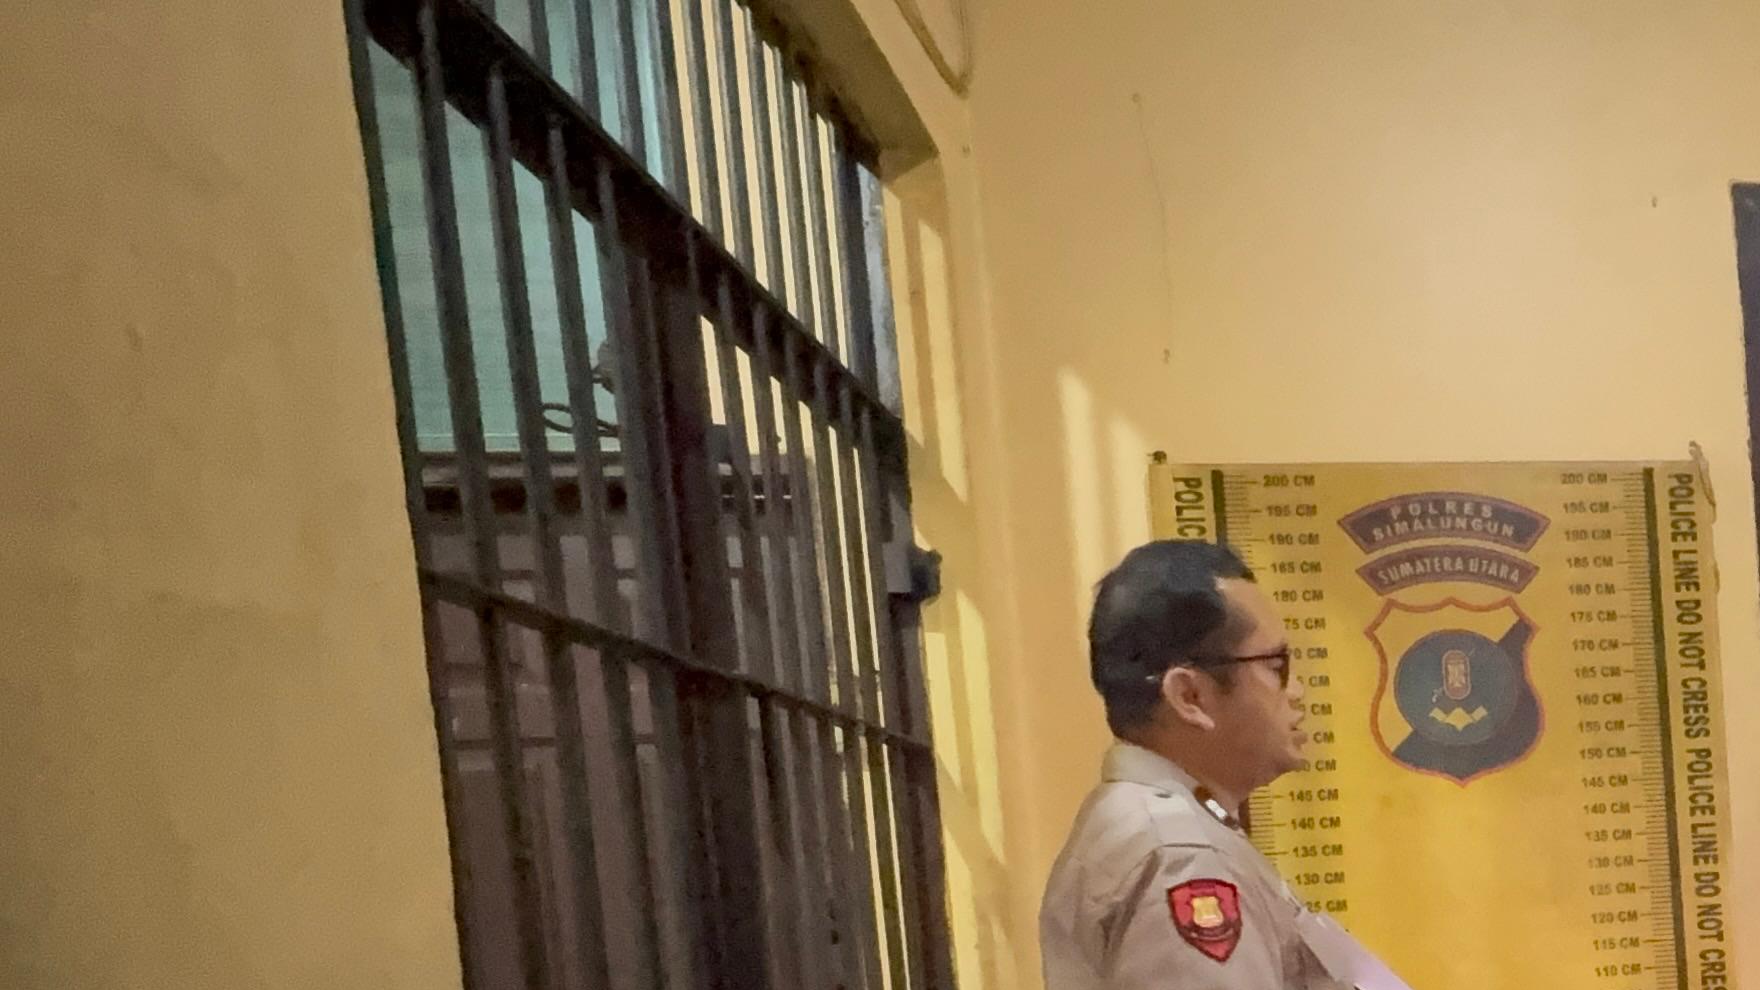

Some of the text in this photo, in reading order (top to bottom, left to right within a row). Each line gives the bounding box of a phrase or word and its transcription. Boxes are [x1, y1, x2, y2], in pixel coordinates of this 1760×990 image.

[1294, 475, 1315, 487] CM
[1588, 473, 1608, 484] CM
[1173, 476, 1207, 538] POLIC
[1296, 504, 1317, 516] CM
[1390, 500, 1493, 520] POLRES
[1590, 502, 1609, 513] CM
[1668, 472, 1698, 543] POLICE
[1372, 516, 1515, 541] SIMALUNGUN
[1592, 529, 1612, 540] CM
[1298, 533, 1319, 545] CM
[1301, 562, 1322, 573] CM
[1593, 557, 1613, 567] CM
[1377, 556, 1520, 584] SUMATERA UTARA
[1672, 549, 1700, 593] LINE
[1596, 584, 1616, 594] CM
[1302, 590, 1324, 601] CM
[1598, 611, 1618, 622] CM
[1675, 600, 1703, 625] DO
[1283, 617, 1326, 630] 75 CM
[1600, 639, 1619, 649] CM
[1307, 647, 1328, 659] CM
[1678, 631, 1706, 671] NOT
[1601, 666, 1621, 677] CM
[1309, 676, 1330, 687] CM
[1603, 693, 1623, 704] CM
[1311, 703, 1332, 715] CM
[1681, 677, 1710, 739] CRESS
[1605, 720, 1625, 731] CM
[1313, 732, 1335, 744] CM
[1606, 747, 1626, 758] CM
[1315, 760, 1337, 771] CM
[1609, 775, 1628, 786] CM
[1685, 748, 1716, 817] POLICE
[1317, 789, 1339, 800] CM
[1611, 802, 1631, 813] CM
[1319, 816, 1341, 828] CM
[1612, 829, 1632, 841] CM
[1321, 844, 1344, 856] CM
[1691, 822, 1719, 866] LINE
[1614, 855, 1634, 867] CM
[1324, 872, 1345, 884] CM
[1616, 882, 1636, 894] CM
[1694, 871, 1721, 898] DO
[1306, 900, 1348, 913] 25 CM
[1618, 910, 1638, 923] CM
[1697, 903, 1724, 942] NOT
[1620, 937, 1640, 949] CM
[1622, 963, 1642, 975] CM
